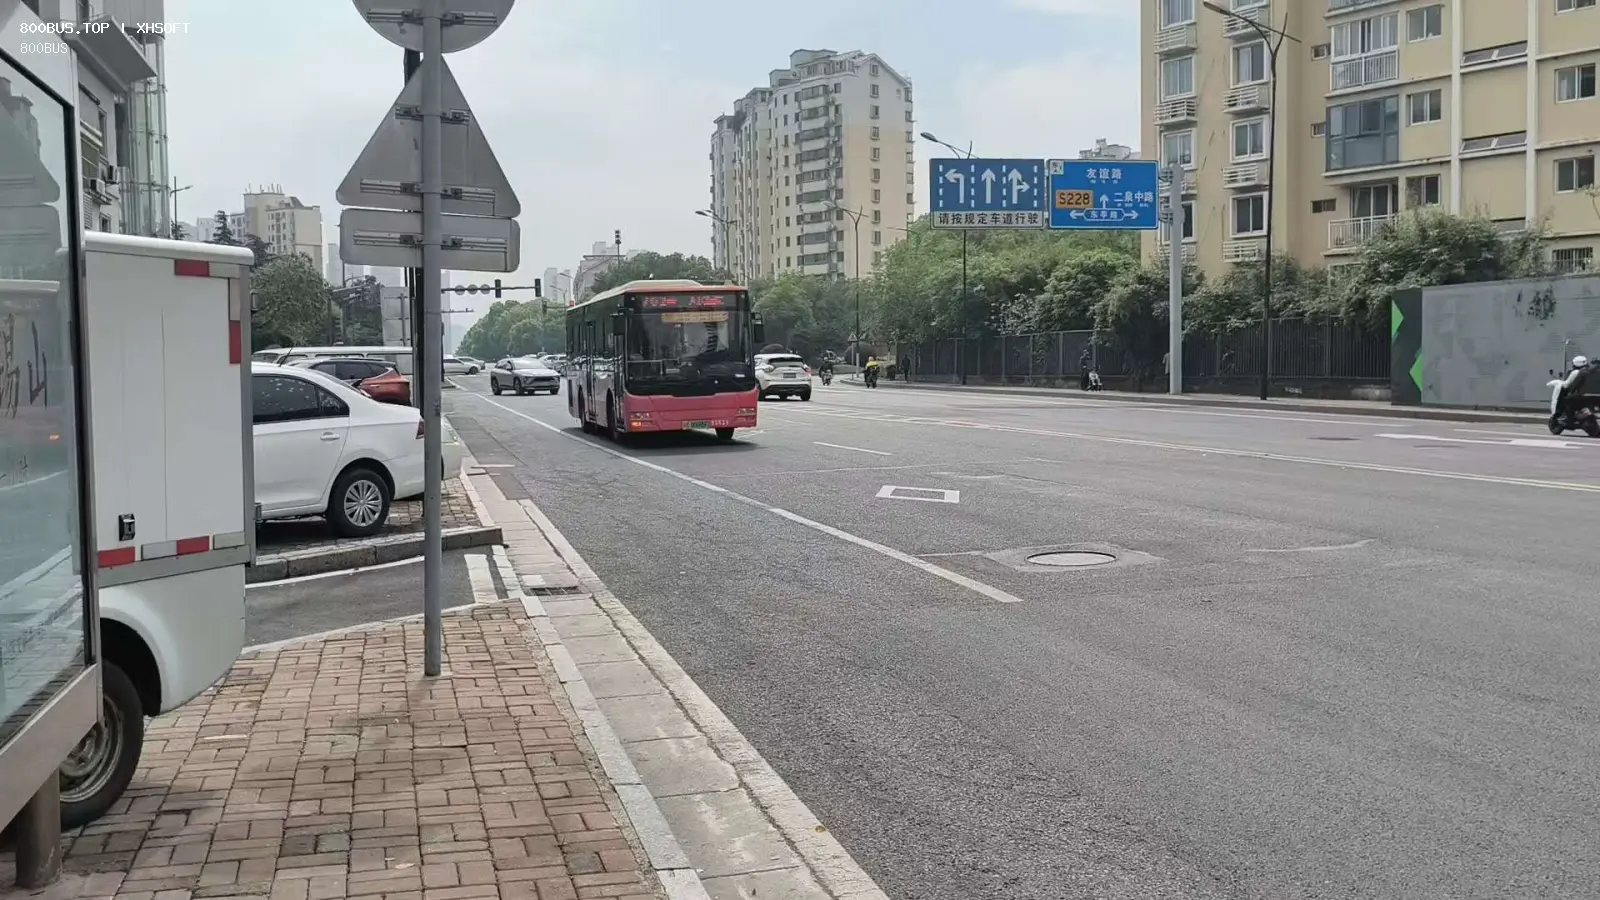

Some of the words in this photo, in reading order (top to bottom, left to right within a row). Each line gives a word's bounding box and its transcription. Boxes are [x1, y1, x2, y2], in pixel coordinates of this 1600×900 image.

[1086, 168, 1122, 179] 友谊路
[1059, 192, 1090, 205] S228
[1114, 191, 1154, 203] 二泉中路
[939, 212, 1039, 225] 请按规定车道行驶
